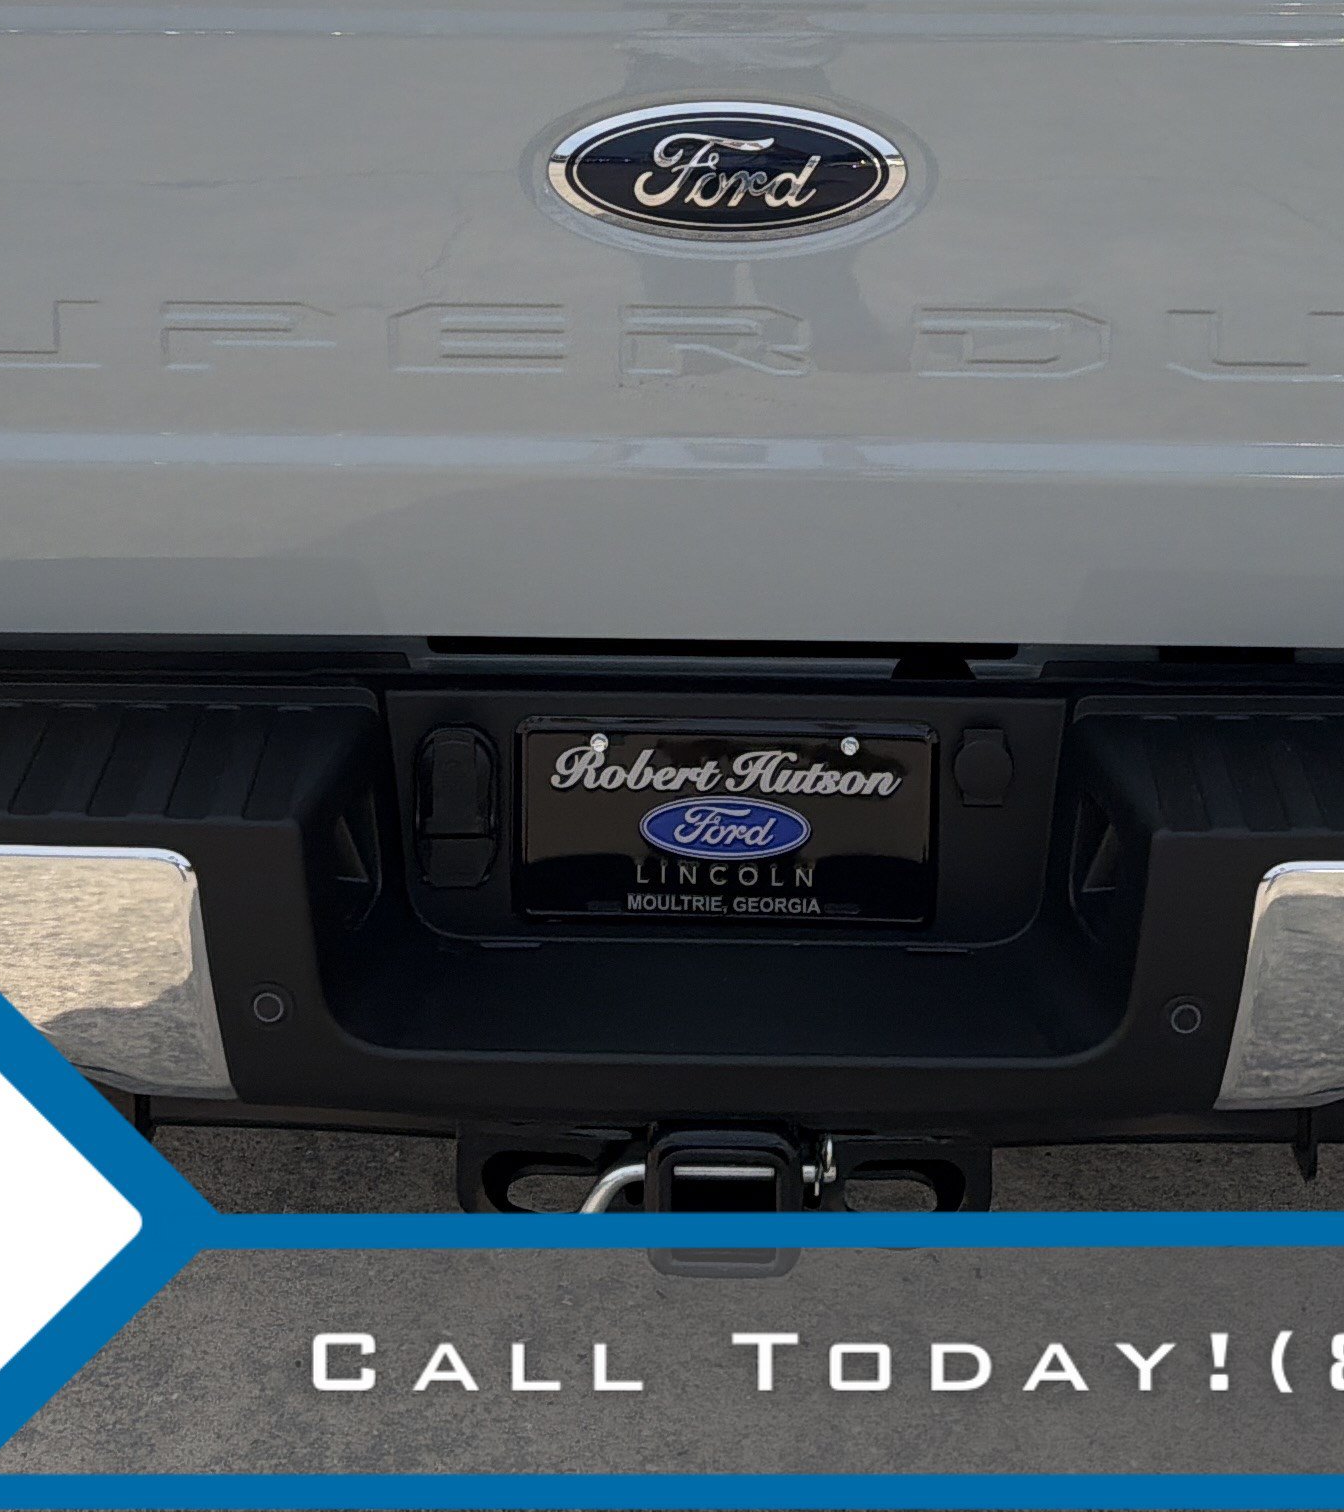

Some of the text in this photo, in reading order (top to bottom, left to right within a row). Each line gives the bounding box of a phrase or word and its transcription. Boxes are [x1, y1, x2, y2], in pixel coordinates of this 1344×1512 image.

[633, 132, 821, 209] Ford
[551, 745, 902, 797] Robert Hutson
[673, 805, 777, 848] Ford
[636, 864, 814, 887] LINCOLN
[627, 893, 822, 915] MOULTRIE, GEORGIA
